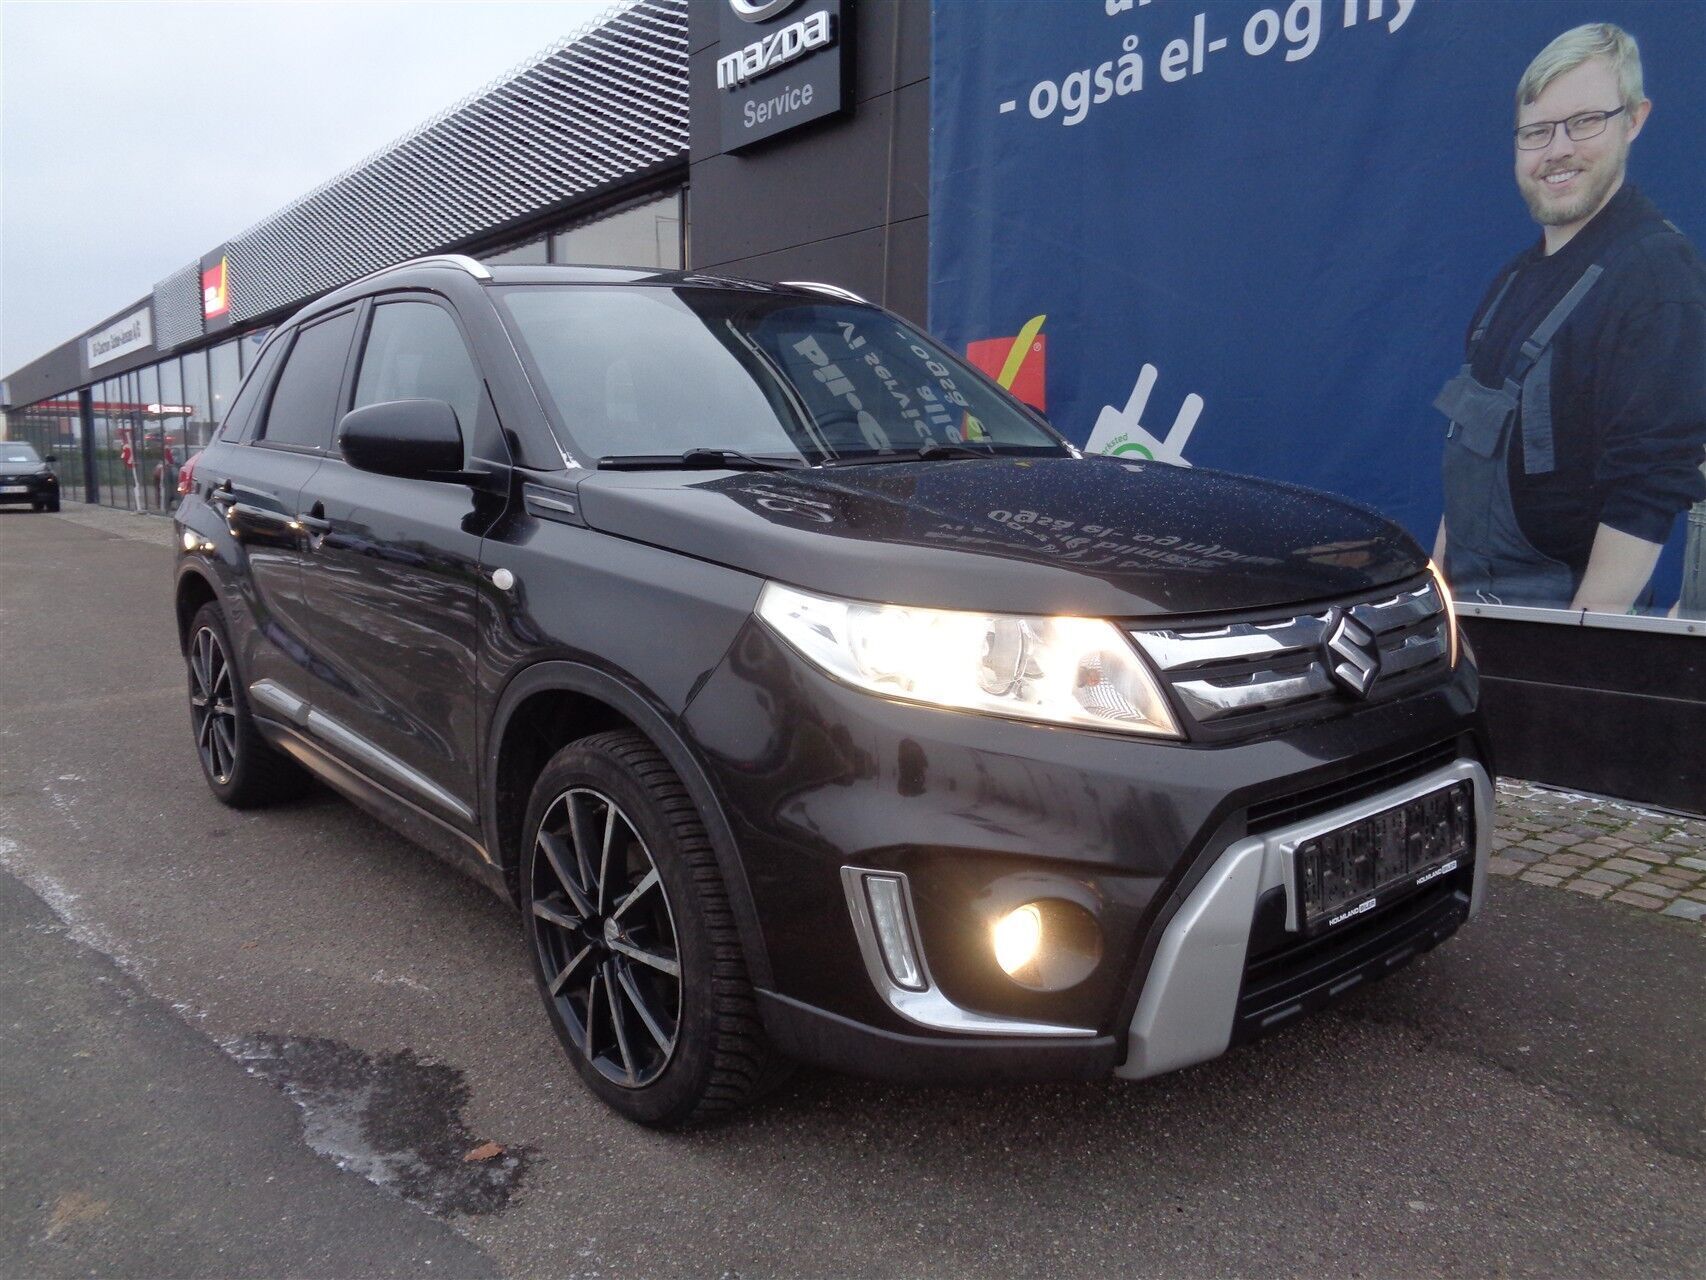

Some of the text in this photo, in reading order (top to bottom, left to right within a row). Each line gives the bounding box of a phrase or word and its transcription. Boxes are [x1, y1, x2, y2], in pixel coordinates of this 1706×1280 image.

[717, 10, 829, 89] mazda
[1028, 34, 1143, 126] også
[1160, 13, 1228, 82] el-
[1243, 0, 1322, 62] og
[744, 83, 813, 128] Service
